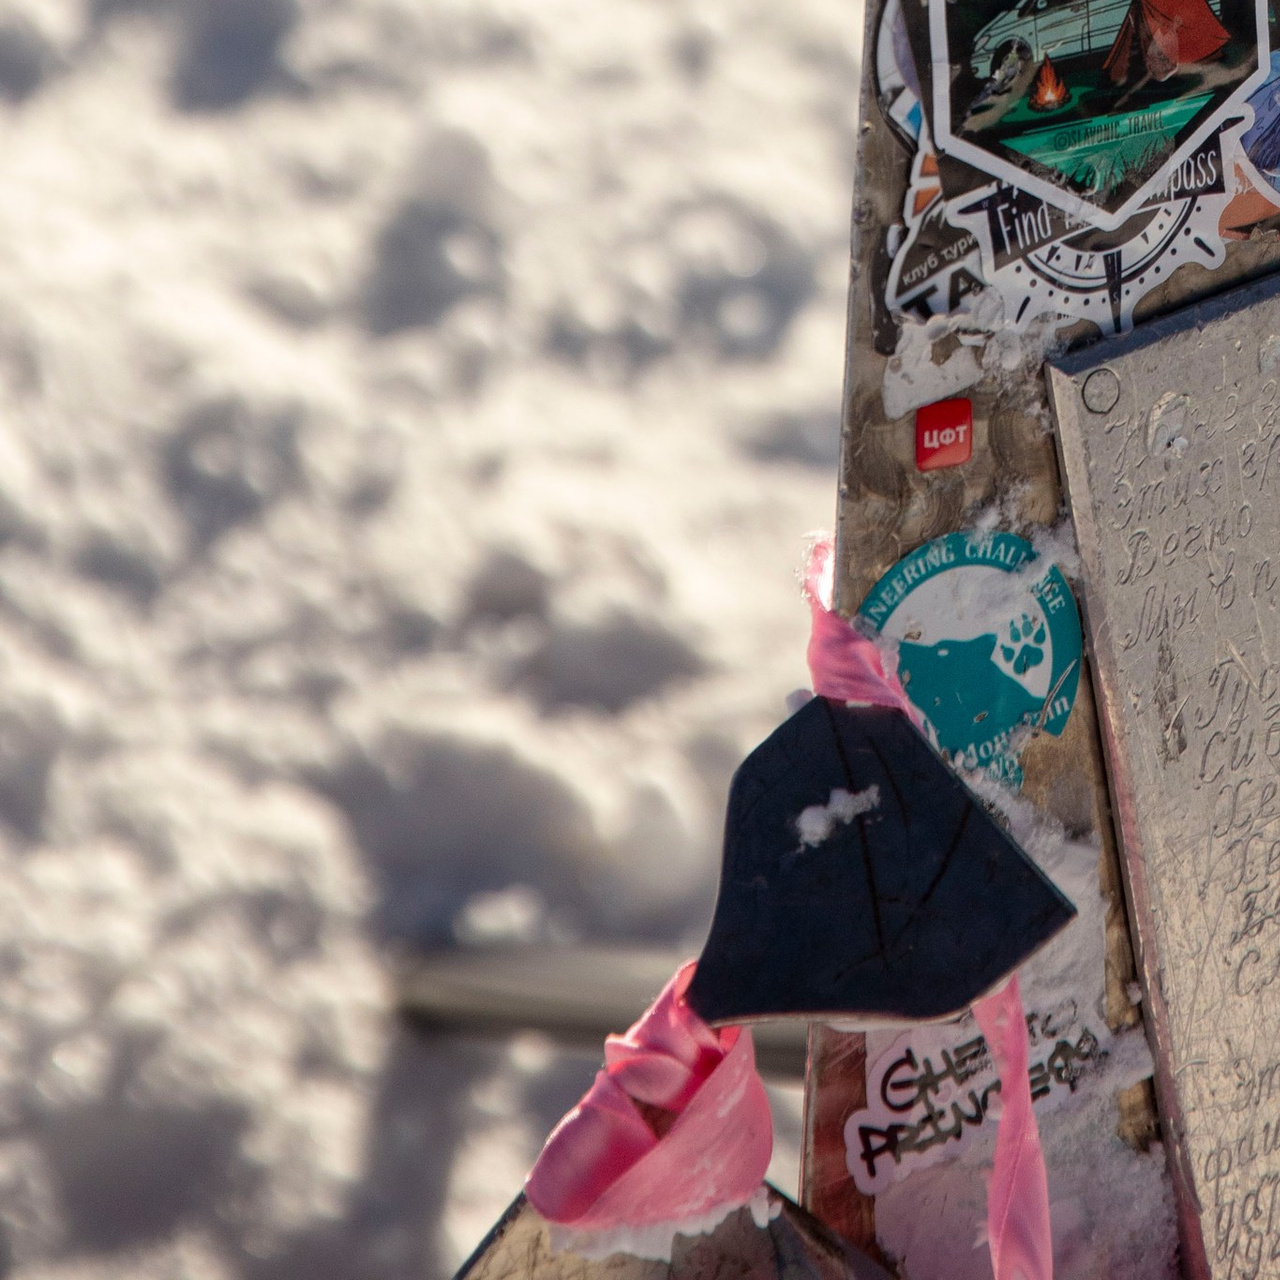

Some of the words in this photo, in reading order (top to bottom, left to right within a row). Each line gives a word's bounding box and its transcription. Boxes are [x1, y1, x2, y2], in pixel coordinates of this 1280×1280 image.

[998, 200, 1053, 256] Find
[901, 252, 939, 285] клуб
[922, 423, 970, 452] ЦФТ
